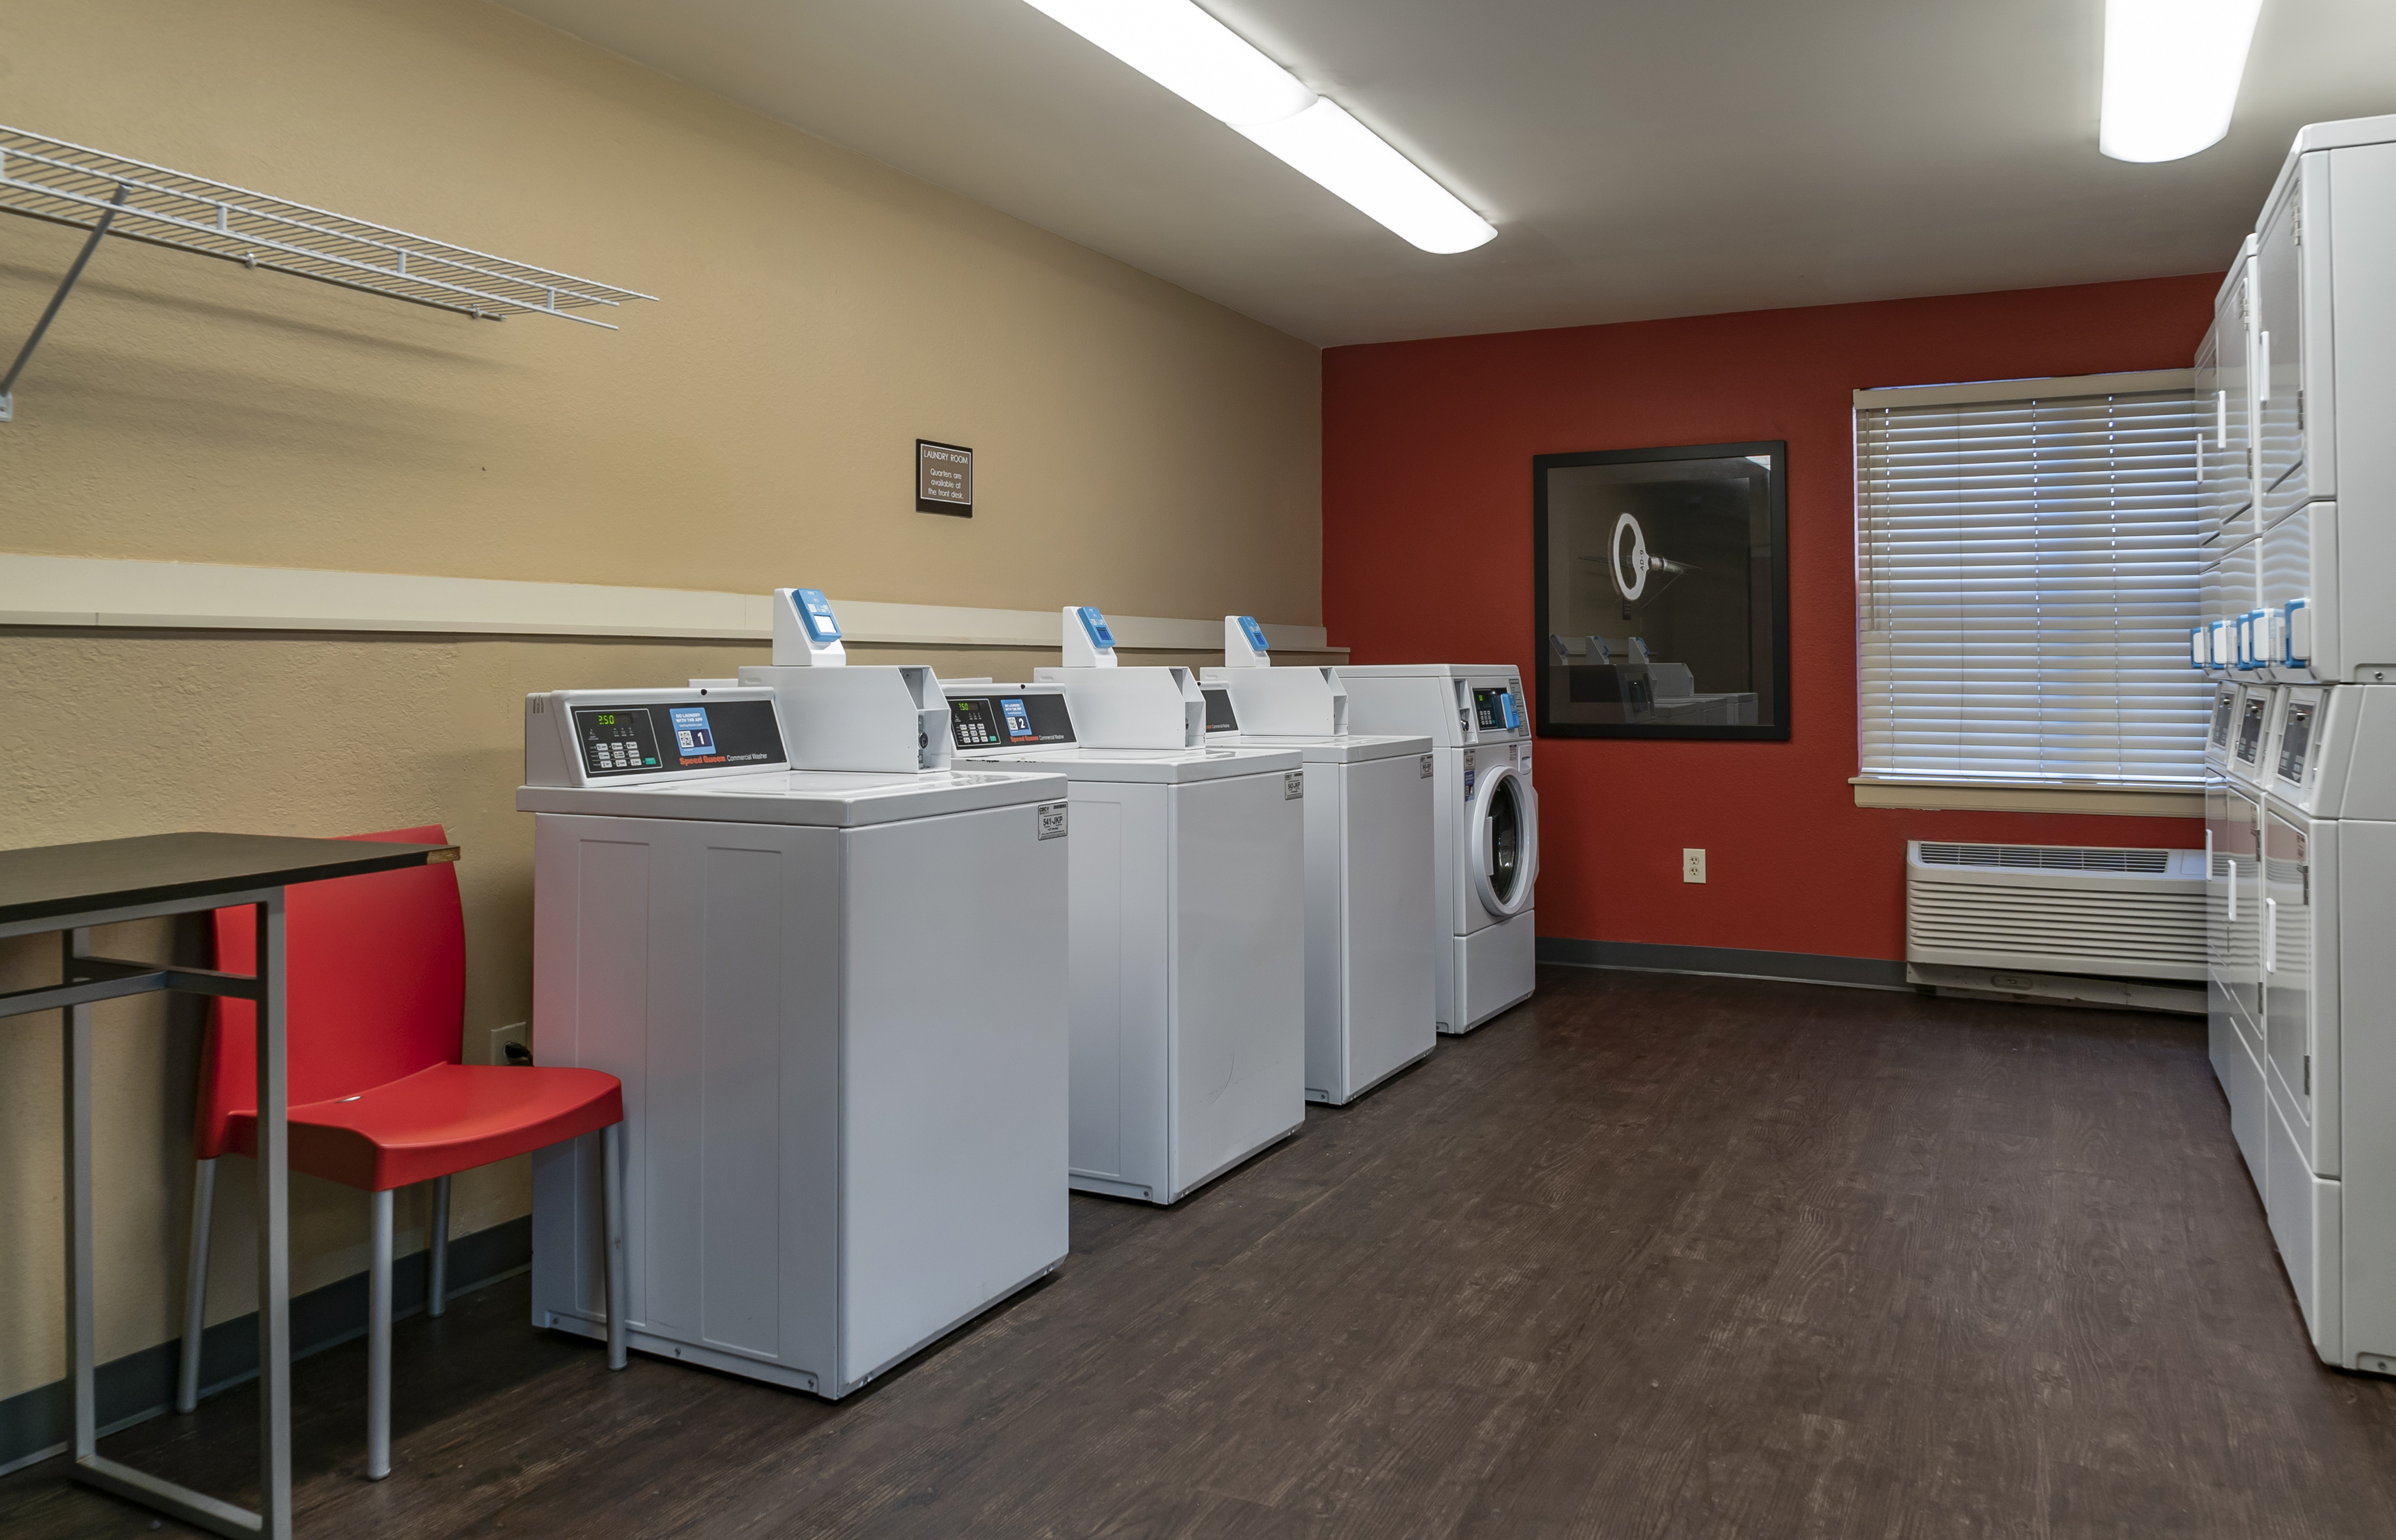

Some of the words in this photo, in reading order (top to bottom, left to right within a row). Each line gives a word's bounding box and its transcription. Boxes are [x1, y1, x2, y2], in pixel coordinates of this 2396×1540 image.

[924, 450, 949, 461] LAUNDRY
[950, 454, 968, 464] ROOM
[930, 468, 952, 478] Quarters
[931, 480, 954, 488] available
[938, 489, 950, 497] front
[1018, 718, 1026, 728] 2
[697, 732, 705, 745] 1
[679, 756, 702, 766] Speed
[1043, 816, 1063, 826] 541-JKP
